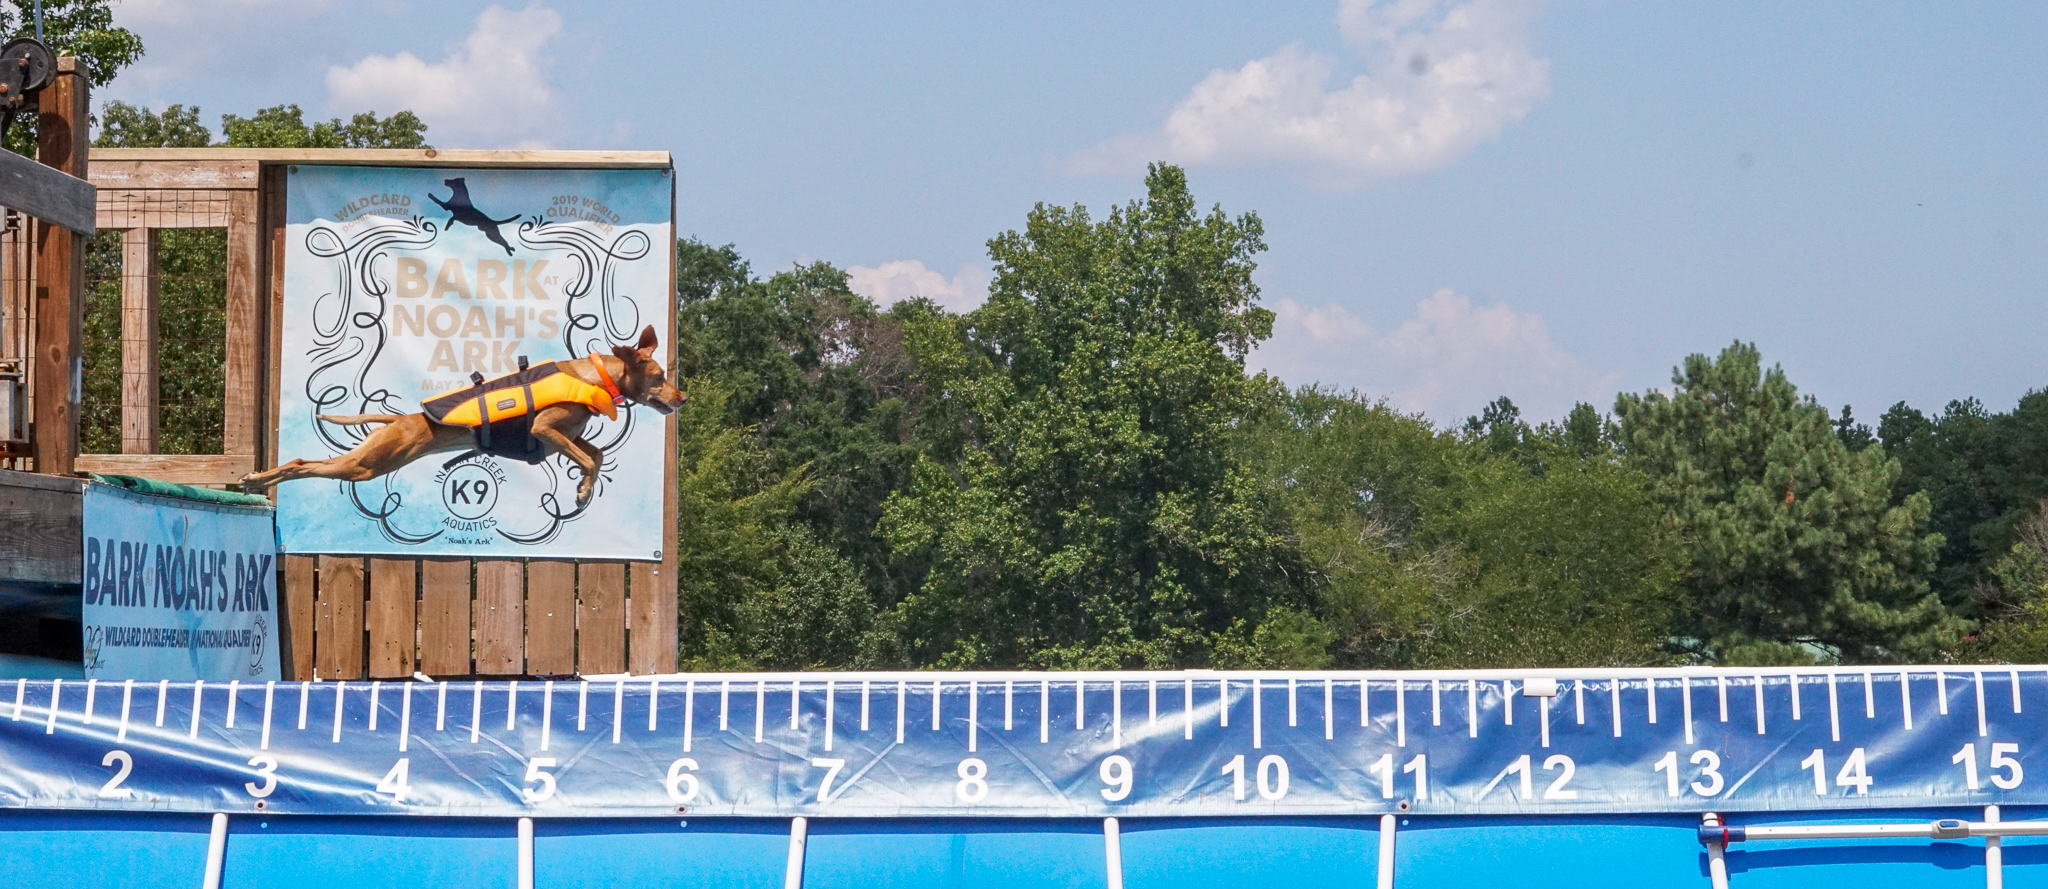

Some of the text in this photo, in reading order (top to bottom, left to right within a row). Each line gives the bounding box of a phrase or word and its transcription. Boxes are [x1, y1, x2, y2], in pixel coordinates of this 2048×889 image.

[334, 193, 411, 222] WILDCARD
[342, 207, 409, 233] DOUBLEHEADER
[546, 207, 614, 235] QUALIFIER
[551, 195, 620, 224] 2019 WORLD
[396, 257, 559, 300] BARK AT
[392, 304, 559, 340] NOAH'S
[427, 340, 521, 373] ARK
[421, 379, 451, 391] MAY
[474, 455, 507, 485] CREEK
[451, 479, 489, 505] K9
[441, 516, 498, 532] AQUATICS
[85, 536, 149, 607] BARK
[153, 544, 229, 613] NOAH'S
[232, 553, 272, 612] ARK
[105, 626, 141, 648] WILDCARD
[141, 627, 189, 649] DOUBLEHEADER
[99, 743, 2022, 803] 2 3 4 5 6 7 8 9 10 11 12 13 14 15
